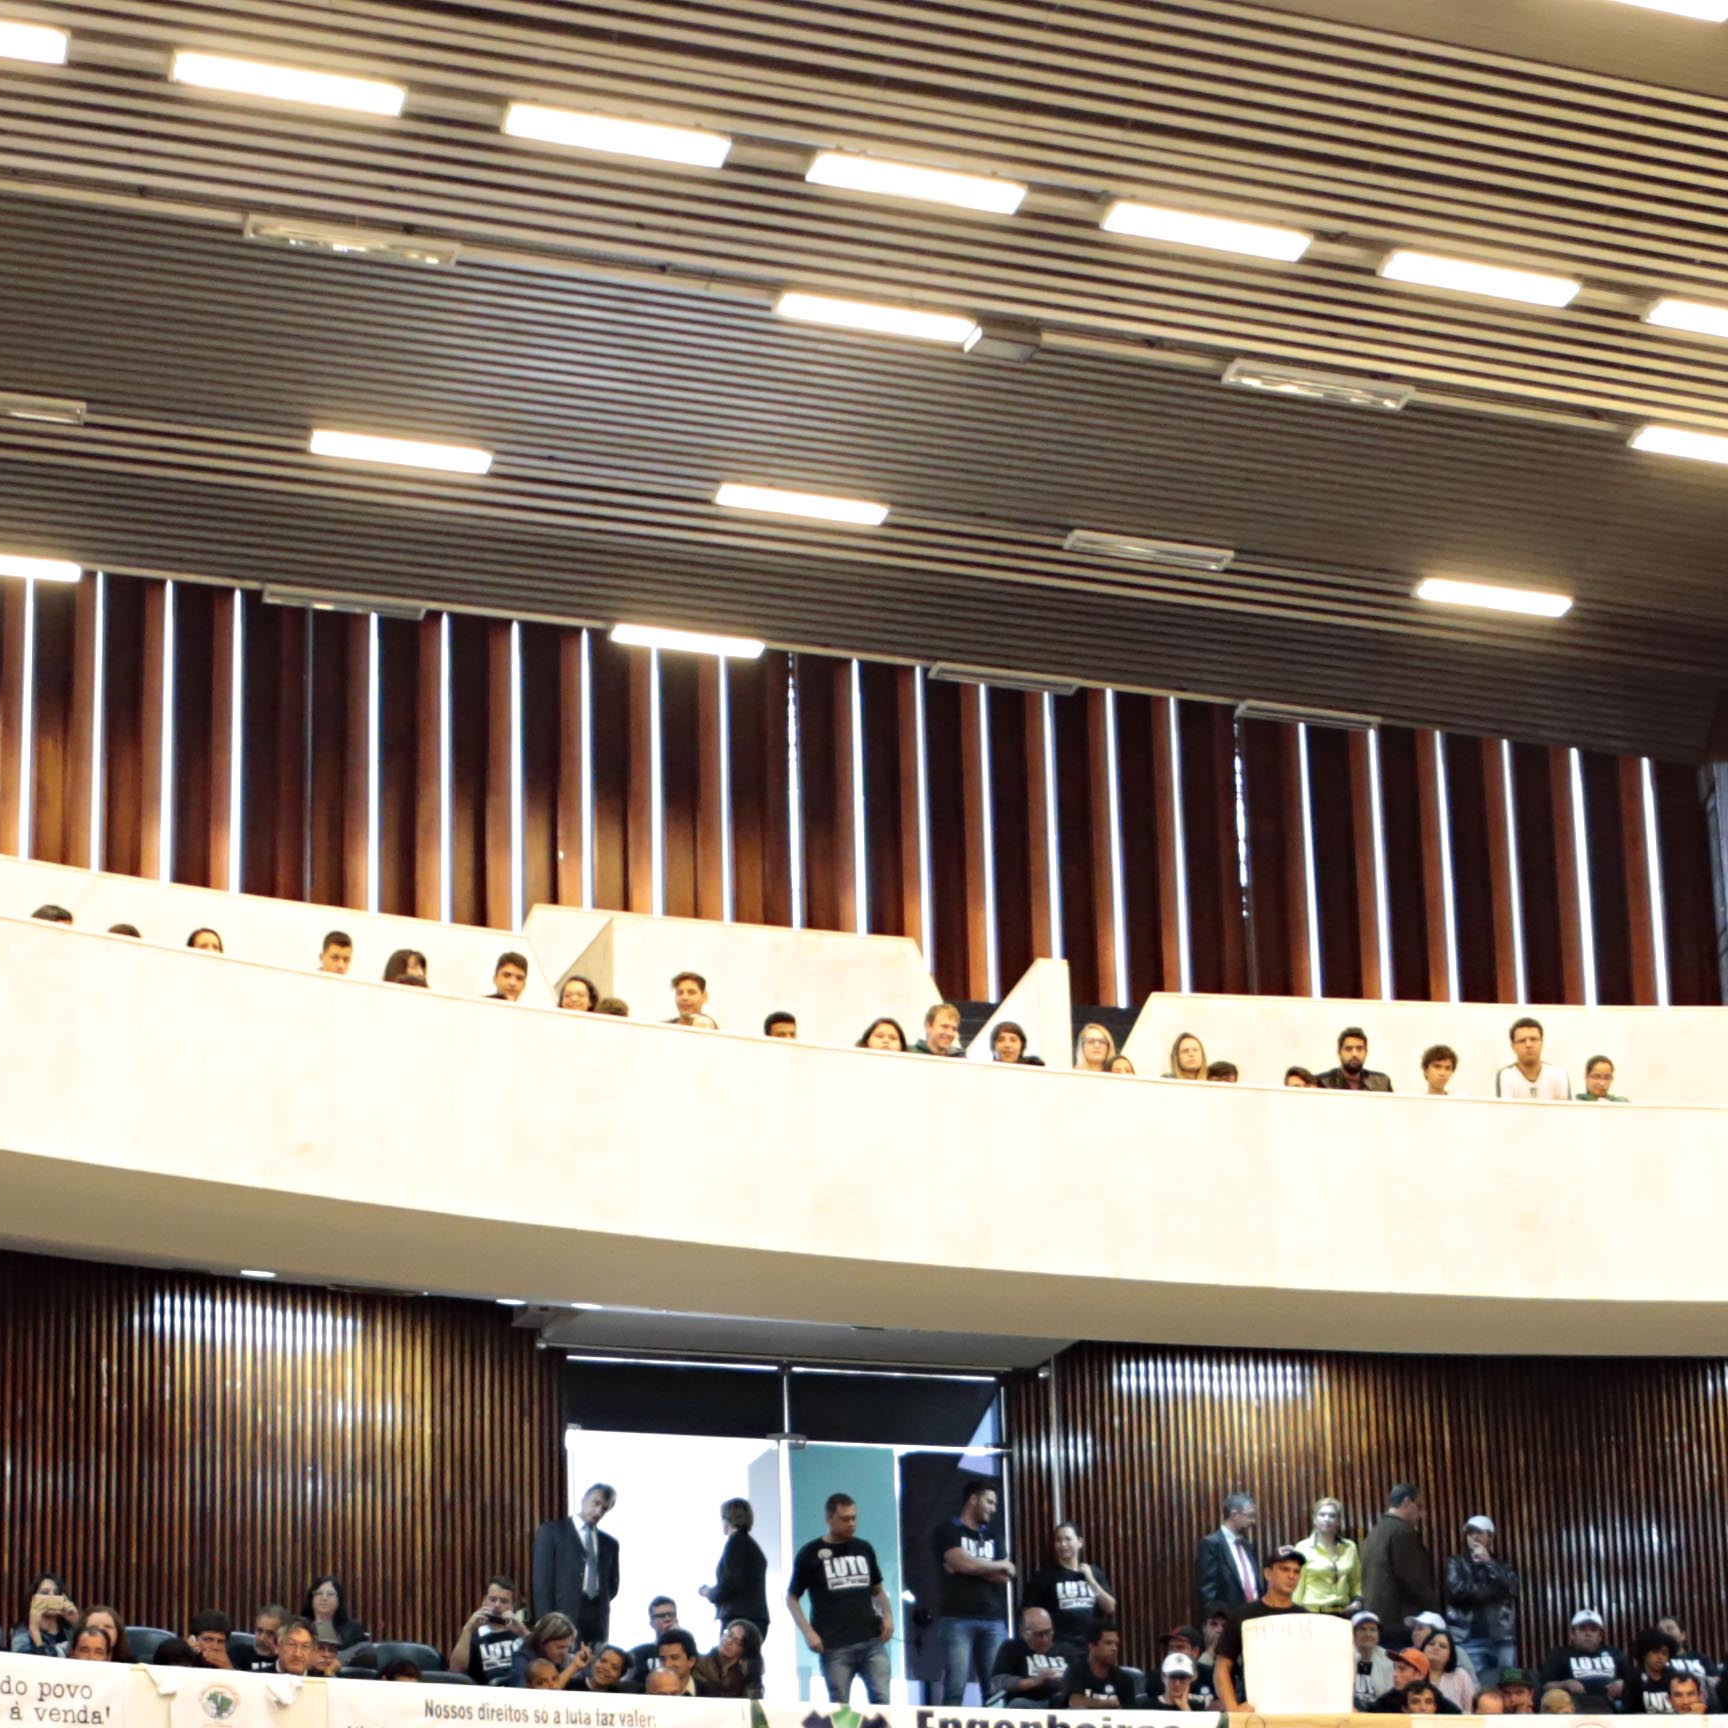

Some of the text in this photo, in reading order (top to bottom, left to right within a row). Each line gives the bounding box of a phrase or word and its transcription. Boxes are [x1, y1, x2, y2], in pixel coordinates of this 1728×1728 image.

[824, 1555, 869, 1579] LUTO
[1570, 1656, 1615, 1673] LUTO
[0, 1674, 28, 1696] do
[38, 1681, 93, 1702] povo
[425, 1699, 657, 1728] Nossos direitos só a luta faz valer:
